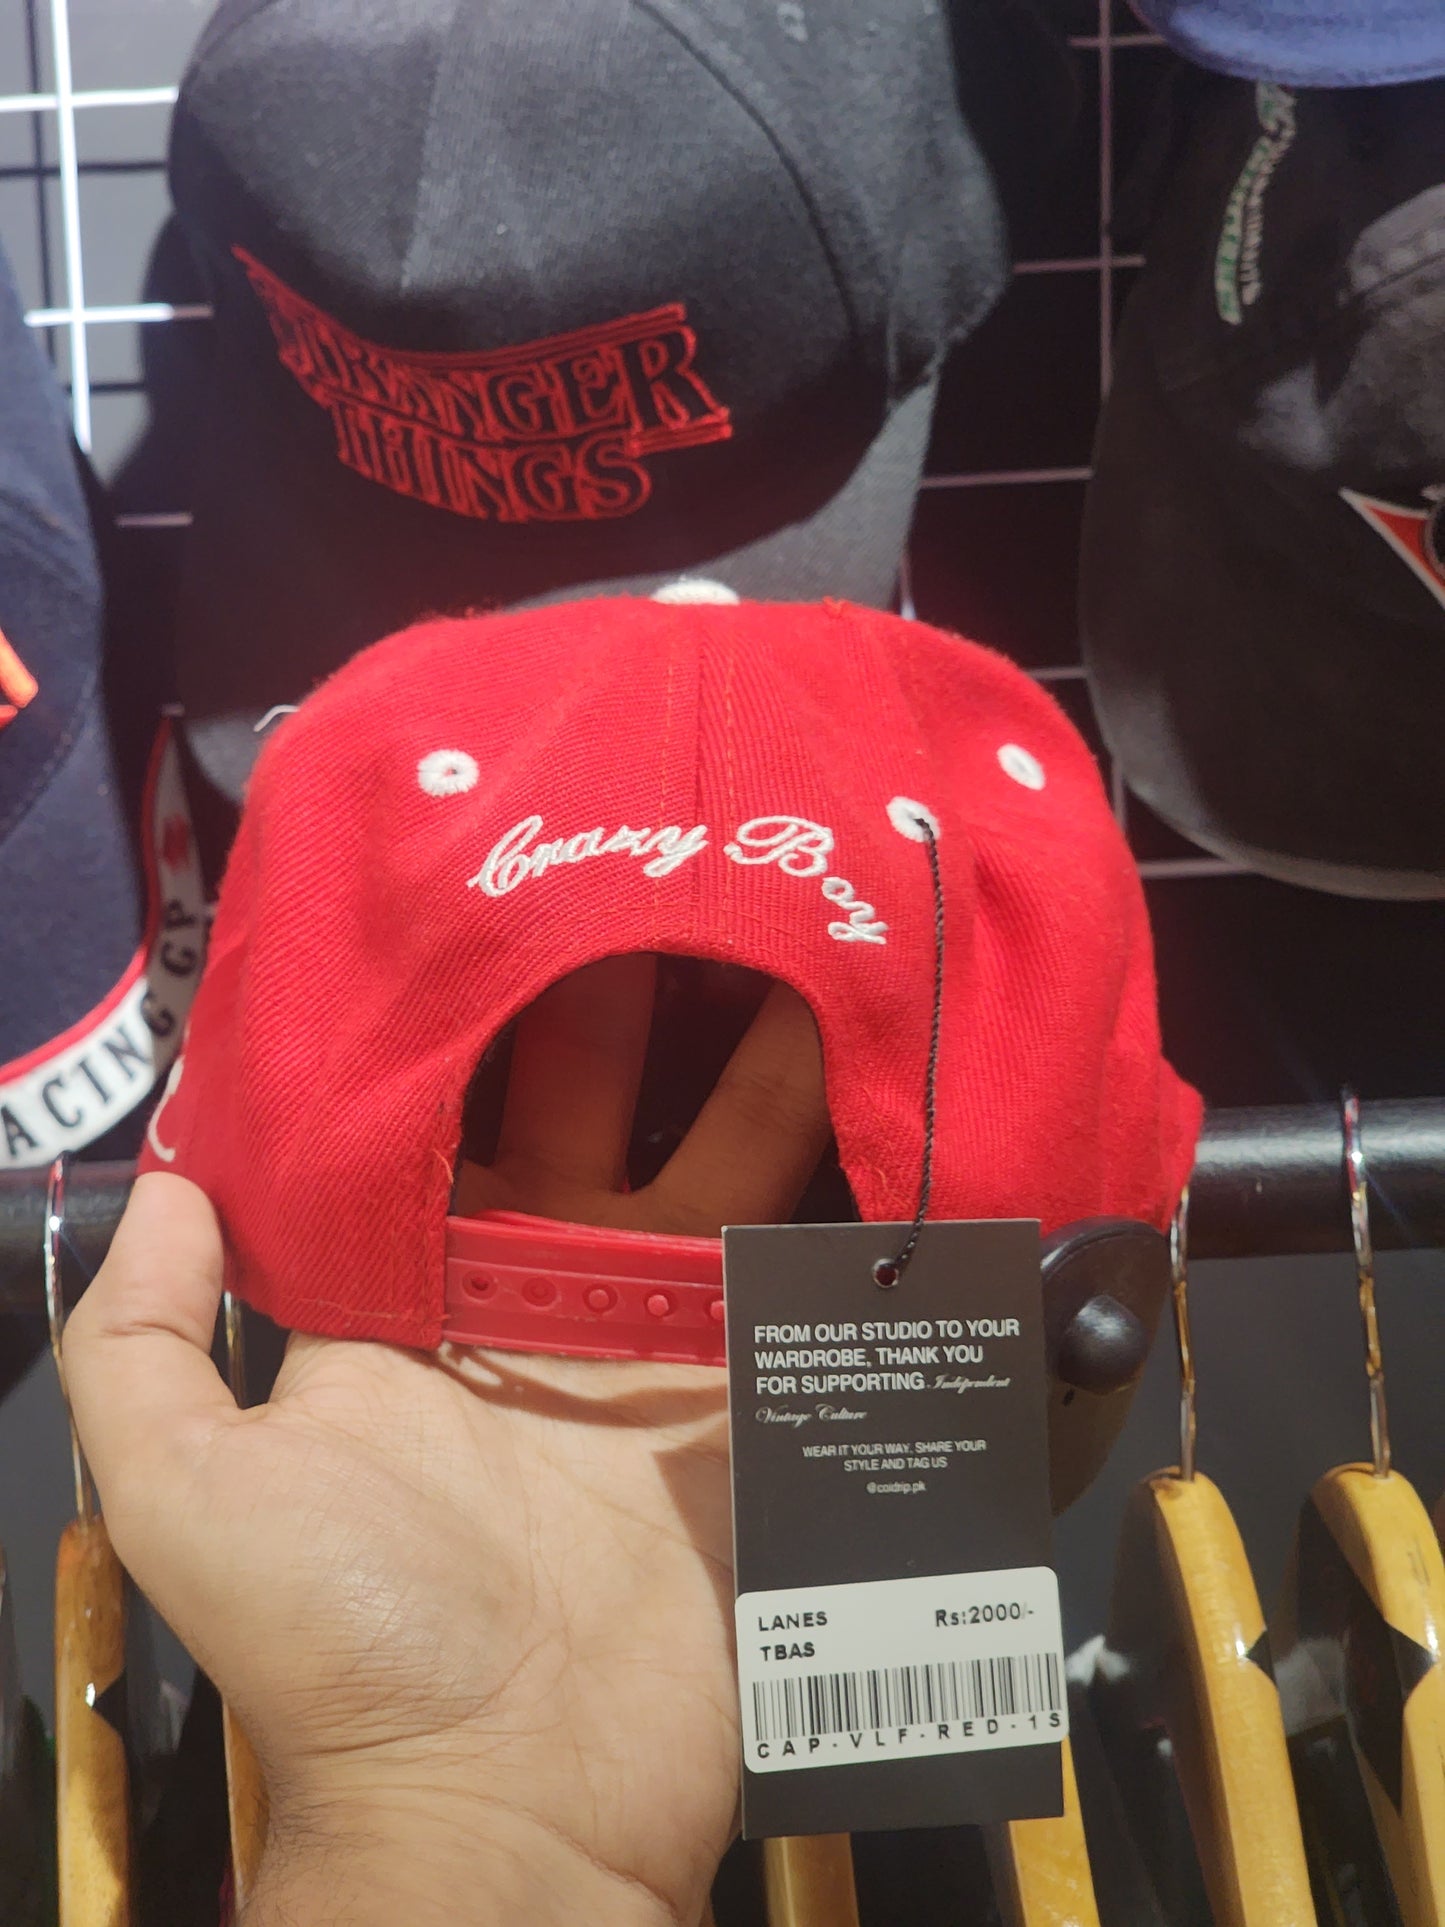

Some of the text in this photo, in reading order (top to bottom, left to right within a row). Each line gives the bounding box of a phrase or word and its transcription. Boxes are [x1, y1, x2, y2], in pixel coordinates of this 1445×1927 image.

[723, 815, 889, 945] Boy
[754, 1318, 1021, 1344] FROM OUR STUDIO TO YOUR
[874, 1346, 940, 1367] THANK
[942, 1345, 984, 1364] YOU
[755, 1375, 798, 1395] FOR
[755, 1403, 868, 1428] Vintage Culture
[802, 1445, 839, 1457] WEAR
[839, 1444, 849, 1456] IT
[850, 1443, 885, 1456] YOUR
[915, 1441, 953, 1454] SHARE
[954, 1440, 987, 1452] YOUR
[843, 1456, 949, 1472] STYLE AND TAG US
[758, 1611, 829, 1633] LANES
[760, 1641, 816, 1662] TBAS
